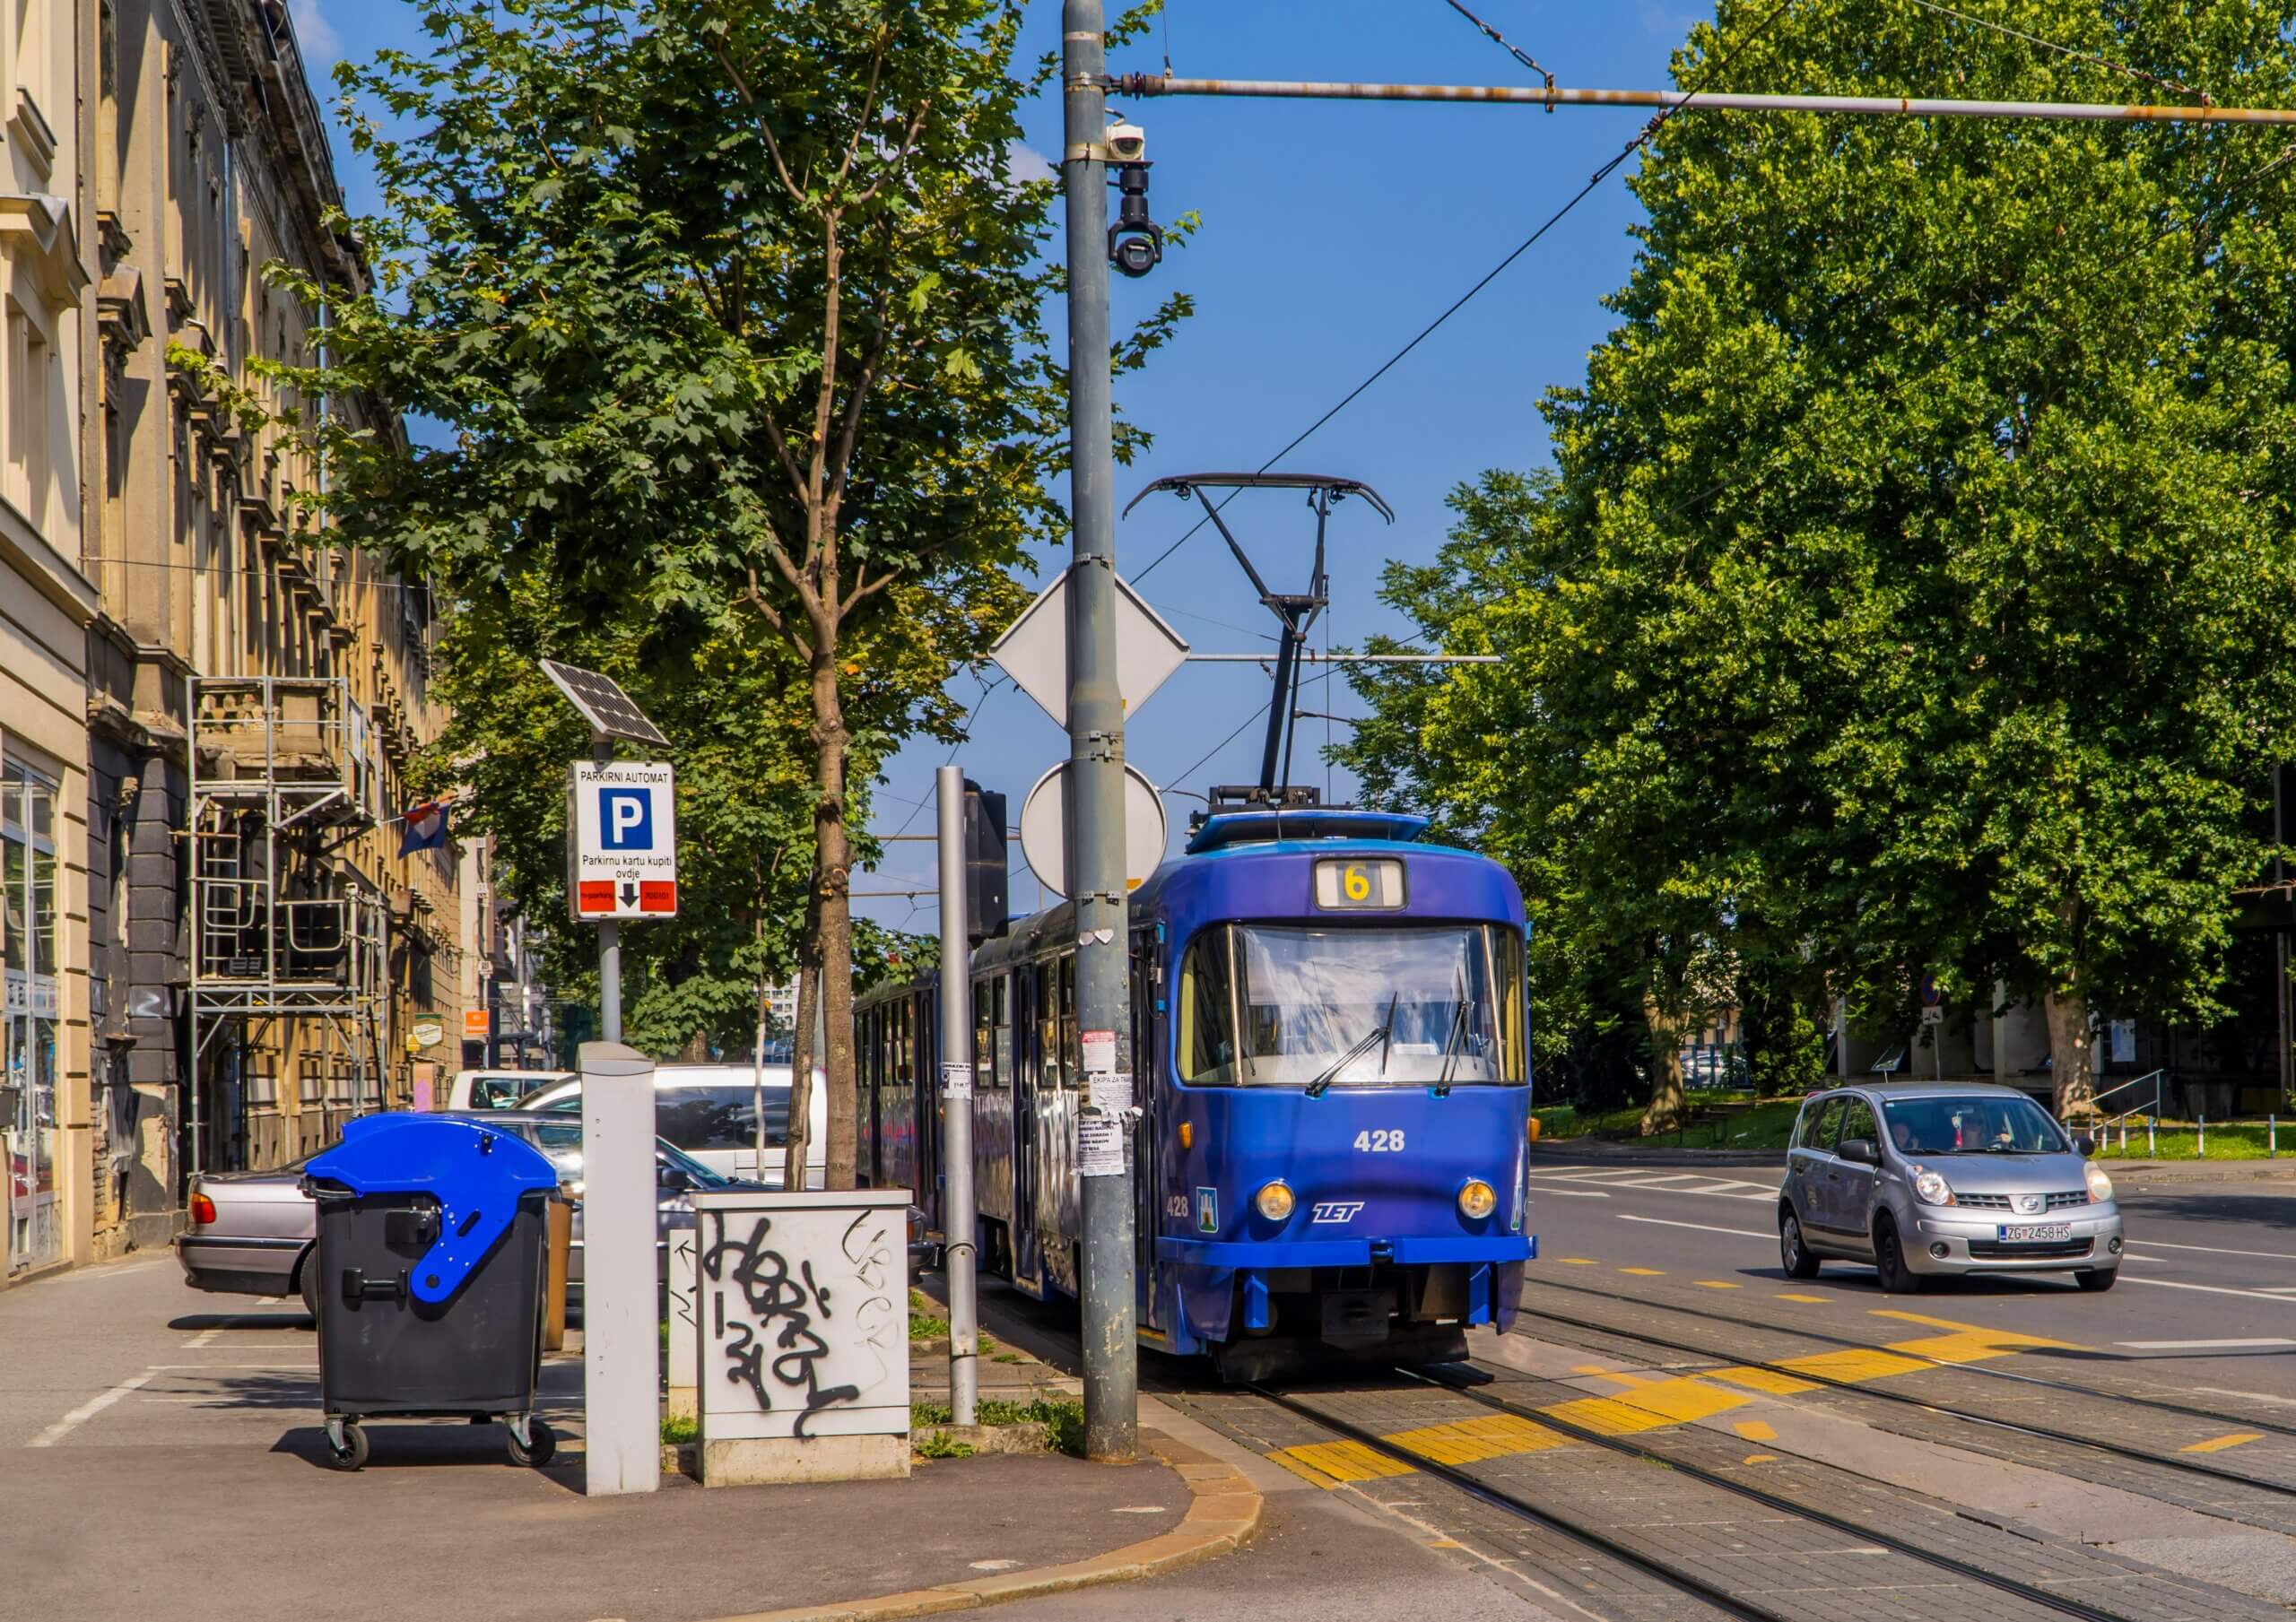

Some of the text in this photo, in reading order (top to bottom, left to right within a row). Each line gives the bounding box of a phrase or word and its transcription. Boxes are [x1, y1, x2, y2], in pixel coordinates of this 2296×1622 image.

[580, 771, 668, 783] PARKIRNI AUTOMAT
[612, 796, 643, 844] P
[582, 854, 673, 869] Parkirnu kartu kupiti
[615, 868, 640, 880] ovdje
[1344, 863, 1370, 901] 6
[1352, 1129, 1405, 1152] 428
[1167, 1195, 1189, 1218] 428
[1312, 1201, 1365, 1223] ZET
[2008, 1227, 2022, 1239] ZG
